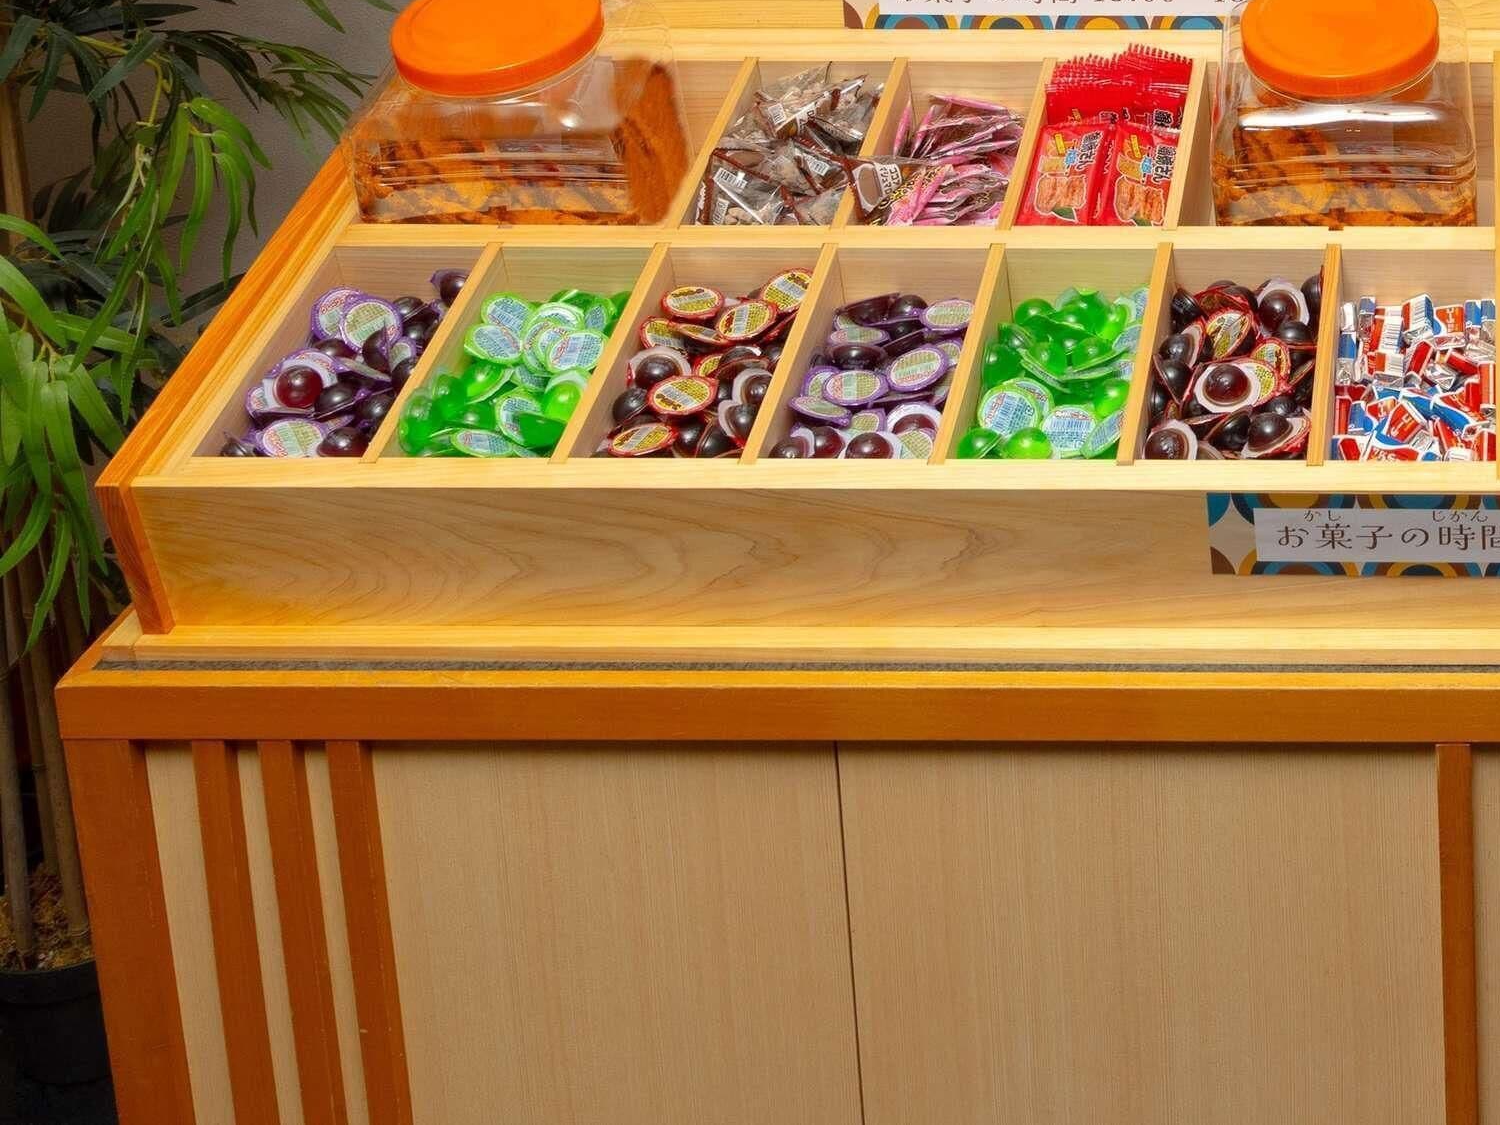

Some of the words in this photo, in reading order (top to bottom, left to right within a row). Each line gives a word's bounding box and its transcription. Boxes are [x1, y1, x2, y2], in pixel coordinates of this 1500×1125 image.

[1302, 510, 1343, 522] かし
[1431, 510, 1489, 522] じかん
